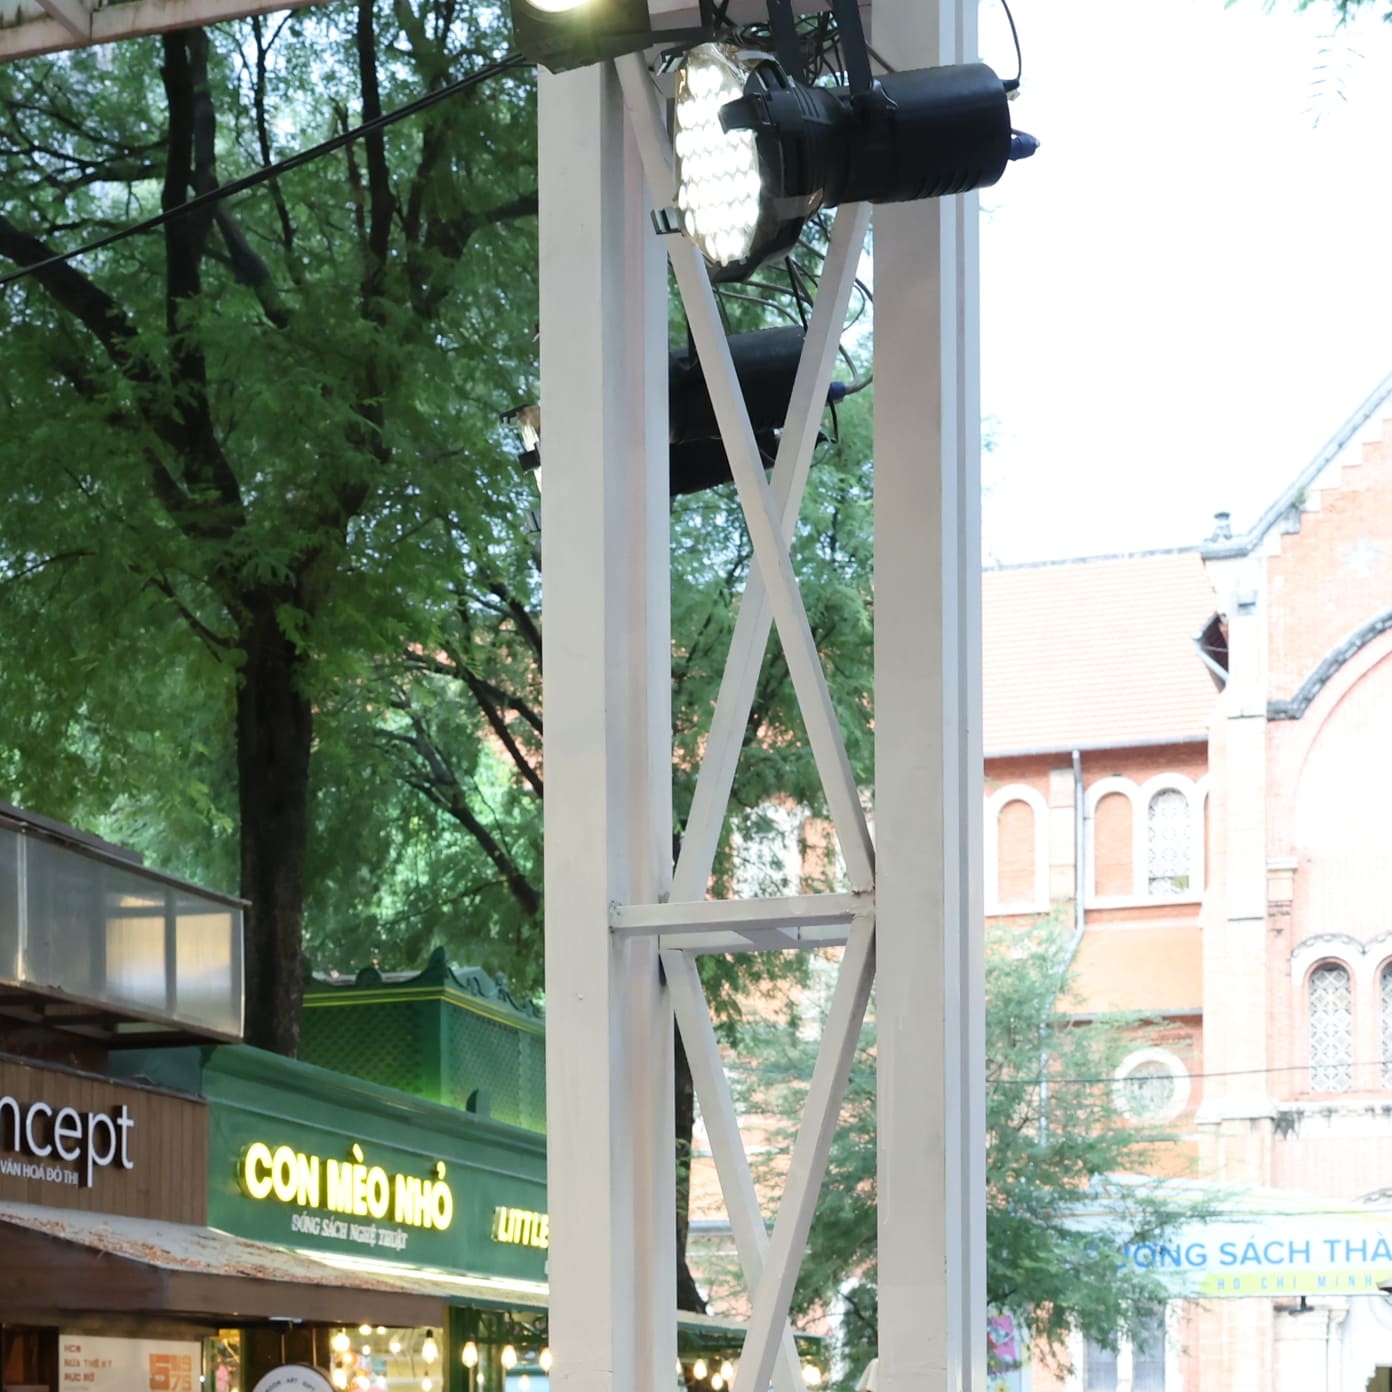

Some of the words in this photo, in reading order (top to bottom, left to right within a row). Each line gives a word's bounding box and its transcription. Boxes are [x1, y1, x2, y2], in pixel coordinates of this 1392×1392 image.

[22, 1159, 45, 1180] HOÁ
[244, 1142, 320, 1208] CON
[326, 1143, 390, 1219] MÈO
[394, 1160, 454, 1230] NHỎ
[321, 1215, 348, 1239] SÁCH
[495, 1206, 549, 1249] LITTLE
[1219, 1234, 1310, 1265] SÁCH
